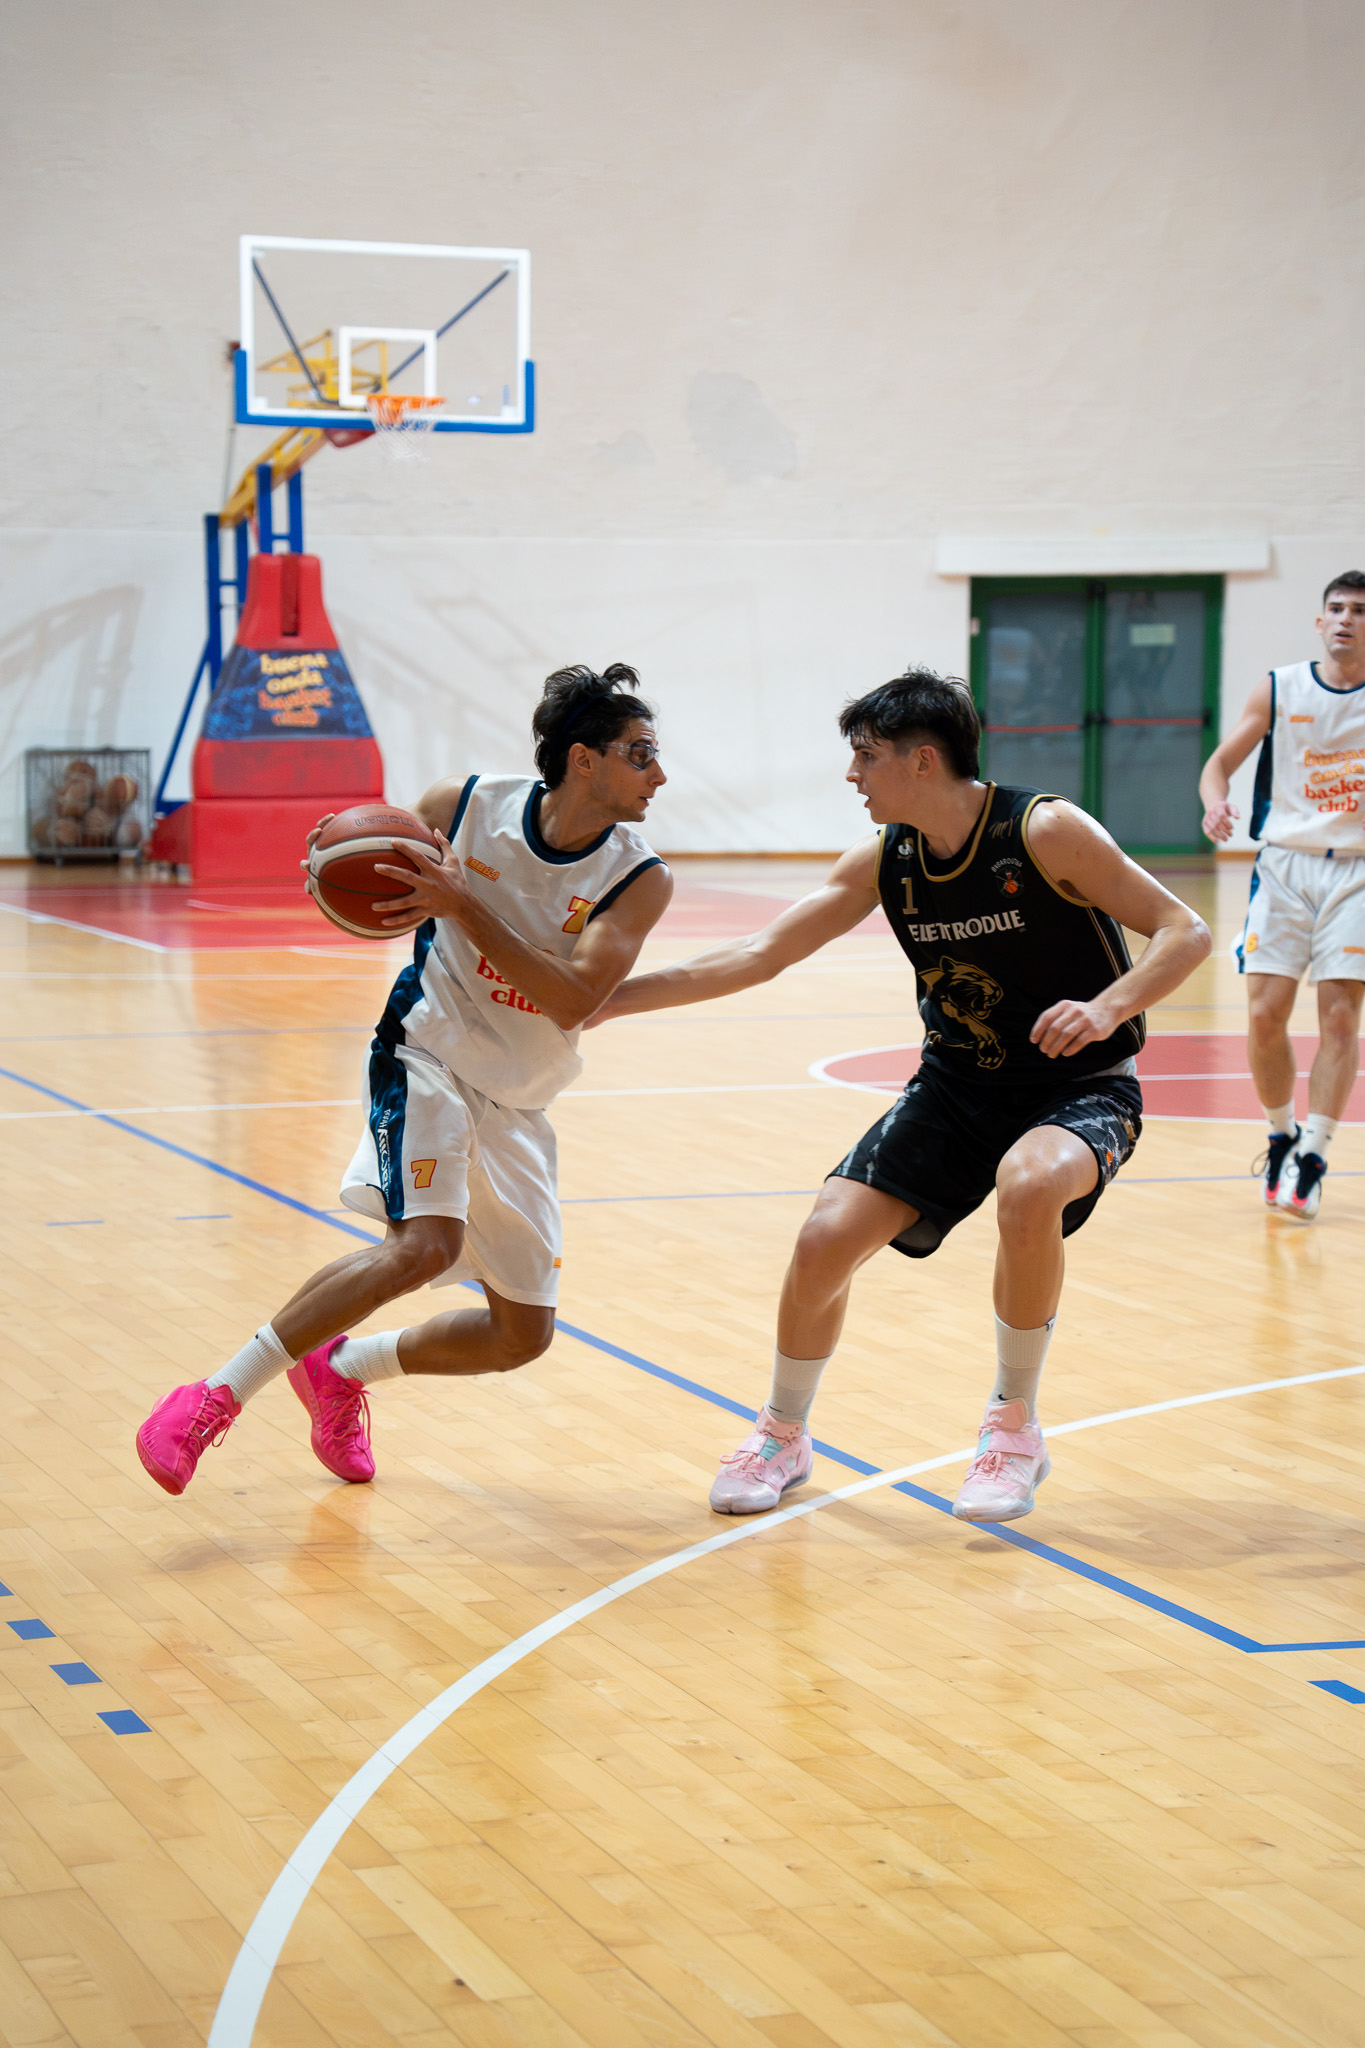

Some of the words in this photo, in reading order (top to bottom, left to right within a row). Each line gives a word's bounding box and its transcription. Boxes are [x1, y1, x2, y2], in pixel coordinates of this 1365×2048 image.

[1309, 763, 1364, 785] onda
[1304, 779, 1365, 799] baske
[1317, 796, 1358, 812] club
[354, 814, 415, 828] molten
[901, 877, 919, 915] 1
[562, 895, 597, 934] 7
[490, 988, 546, 1016] clu
[411, 1159, 437, 1189] 7
